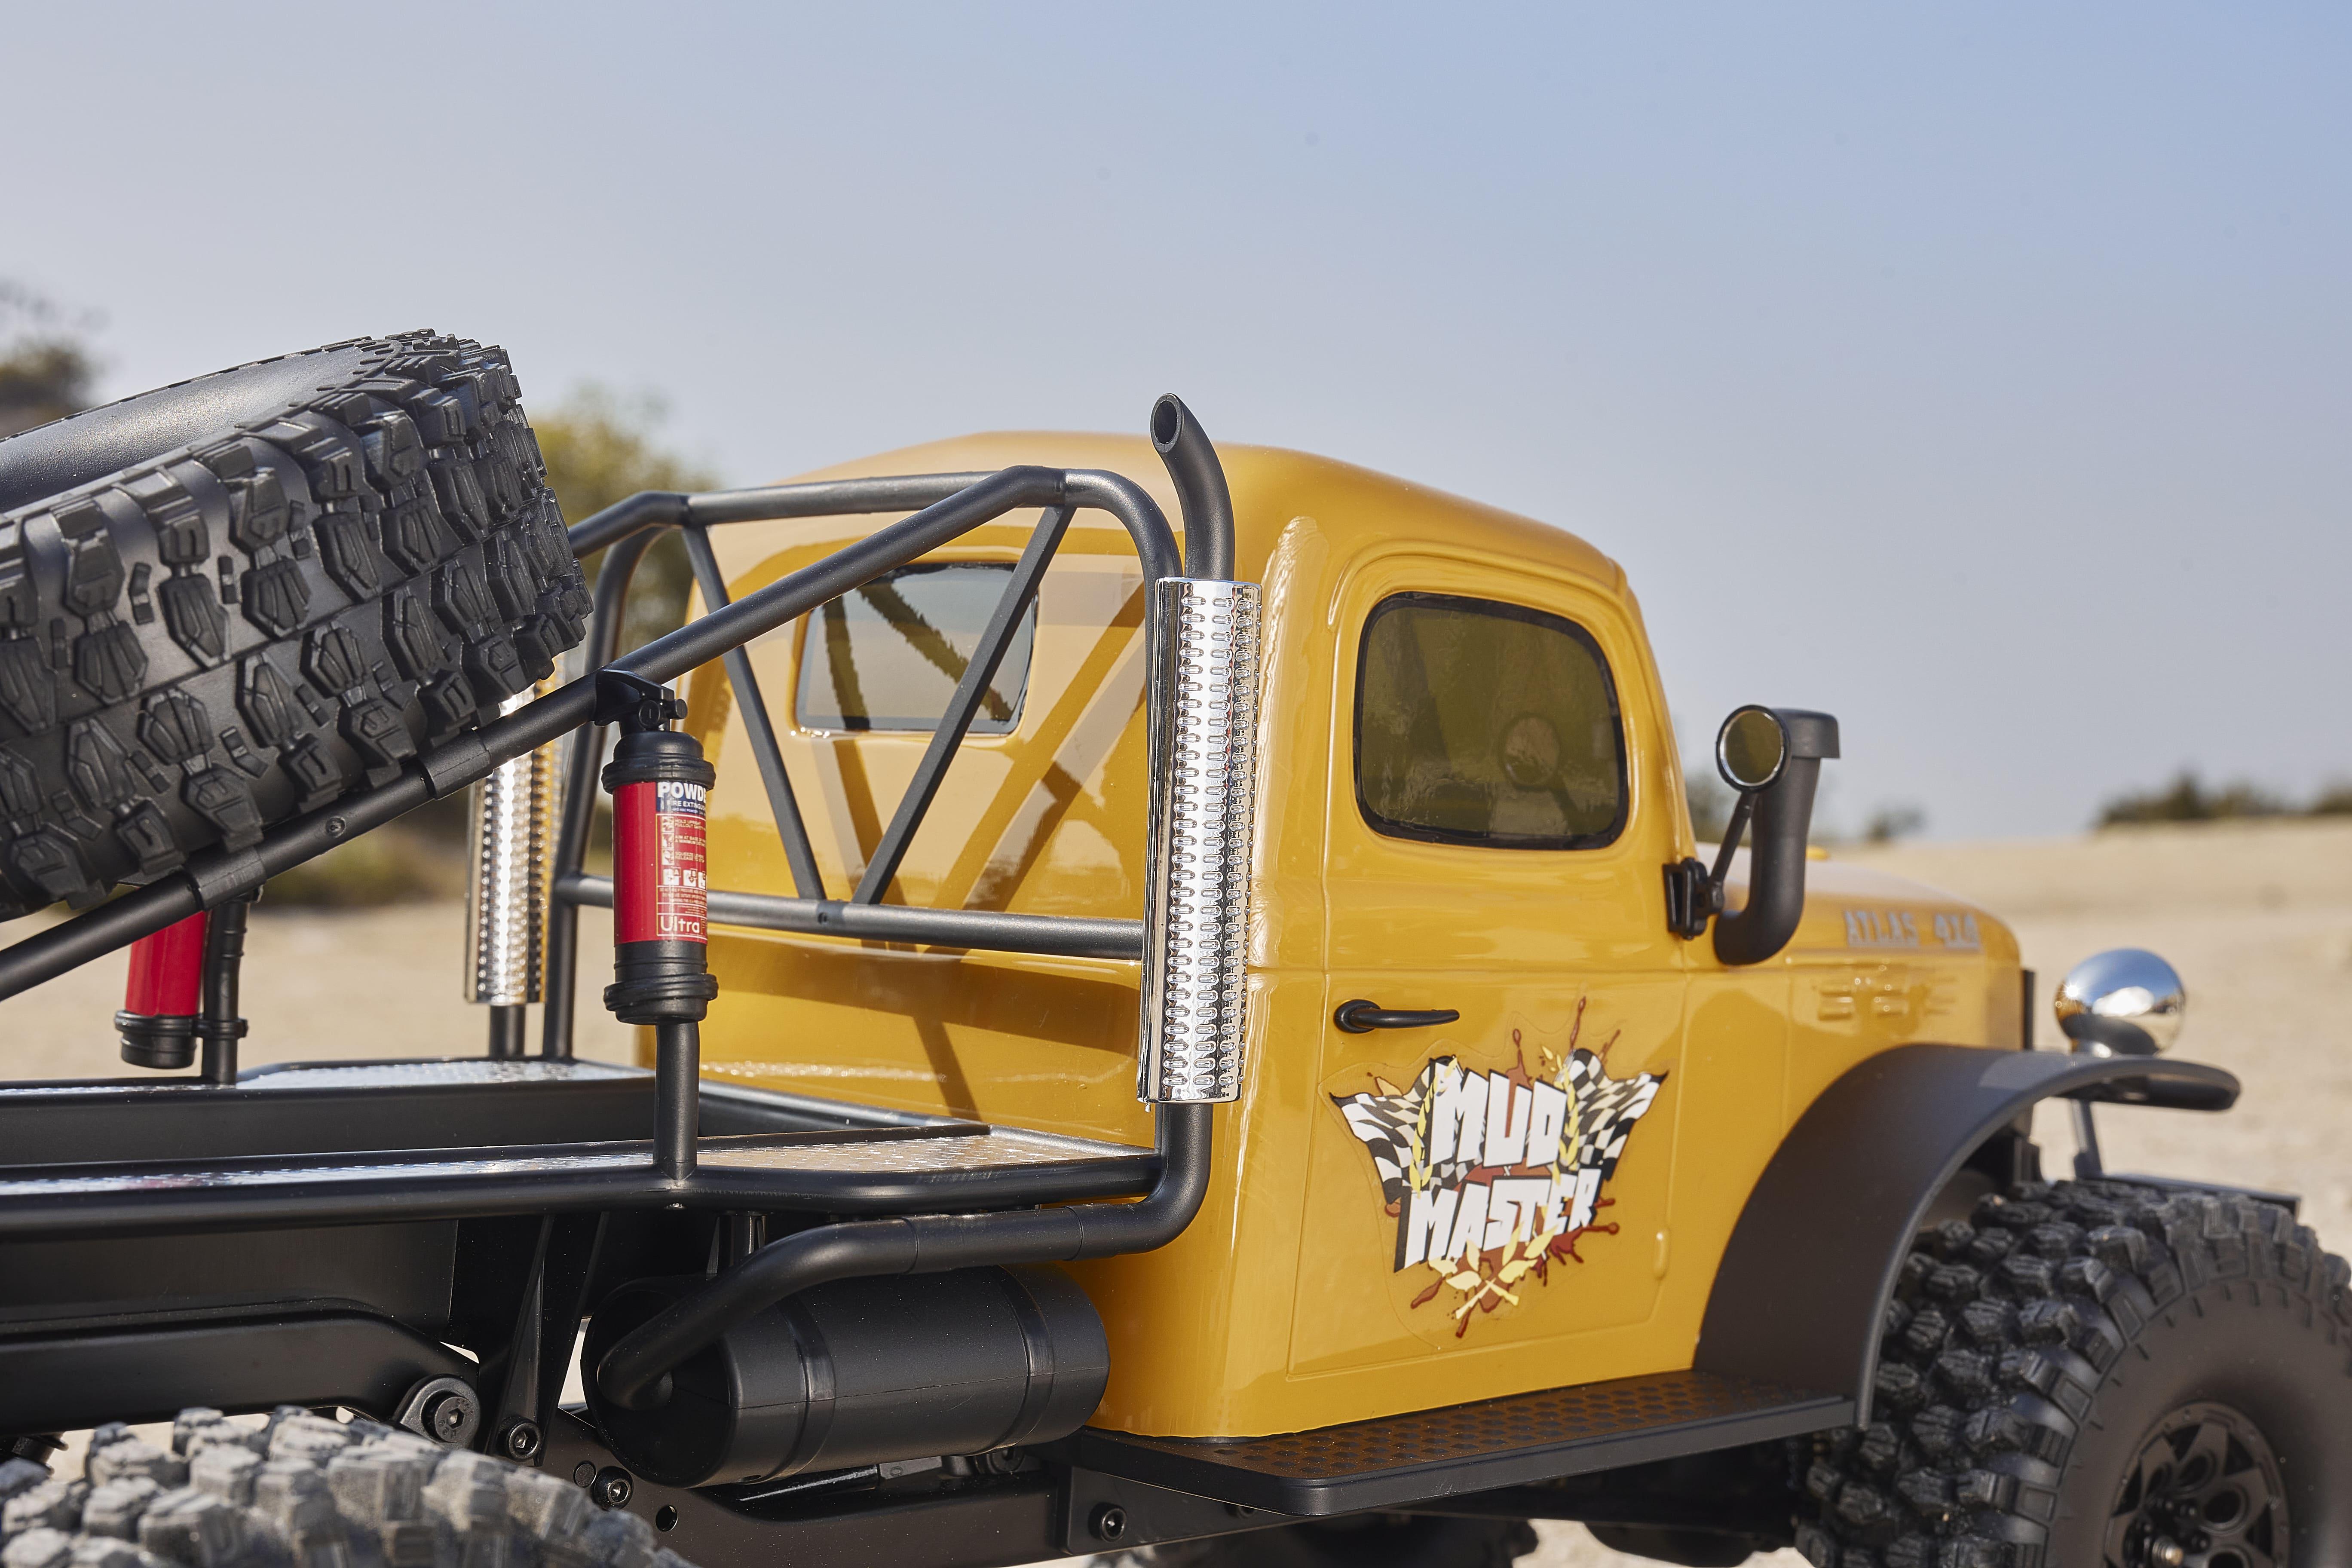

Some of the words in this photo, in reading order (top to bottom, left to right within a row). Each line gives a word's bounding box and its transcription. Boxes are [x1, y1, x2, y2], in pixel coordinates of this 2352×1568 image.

[1844, 910, 1920, 948] ATLAS
[1430, 1062, 1567, 1168] MUD
[1400, 1167, 1602, 1269] MASTER
